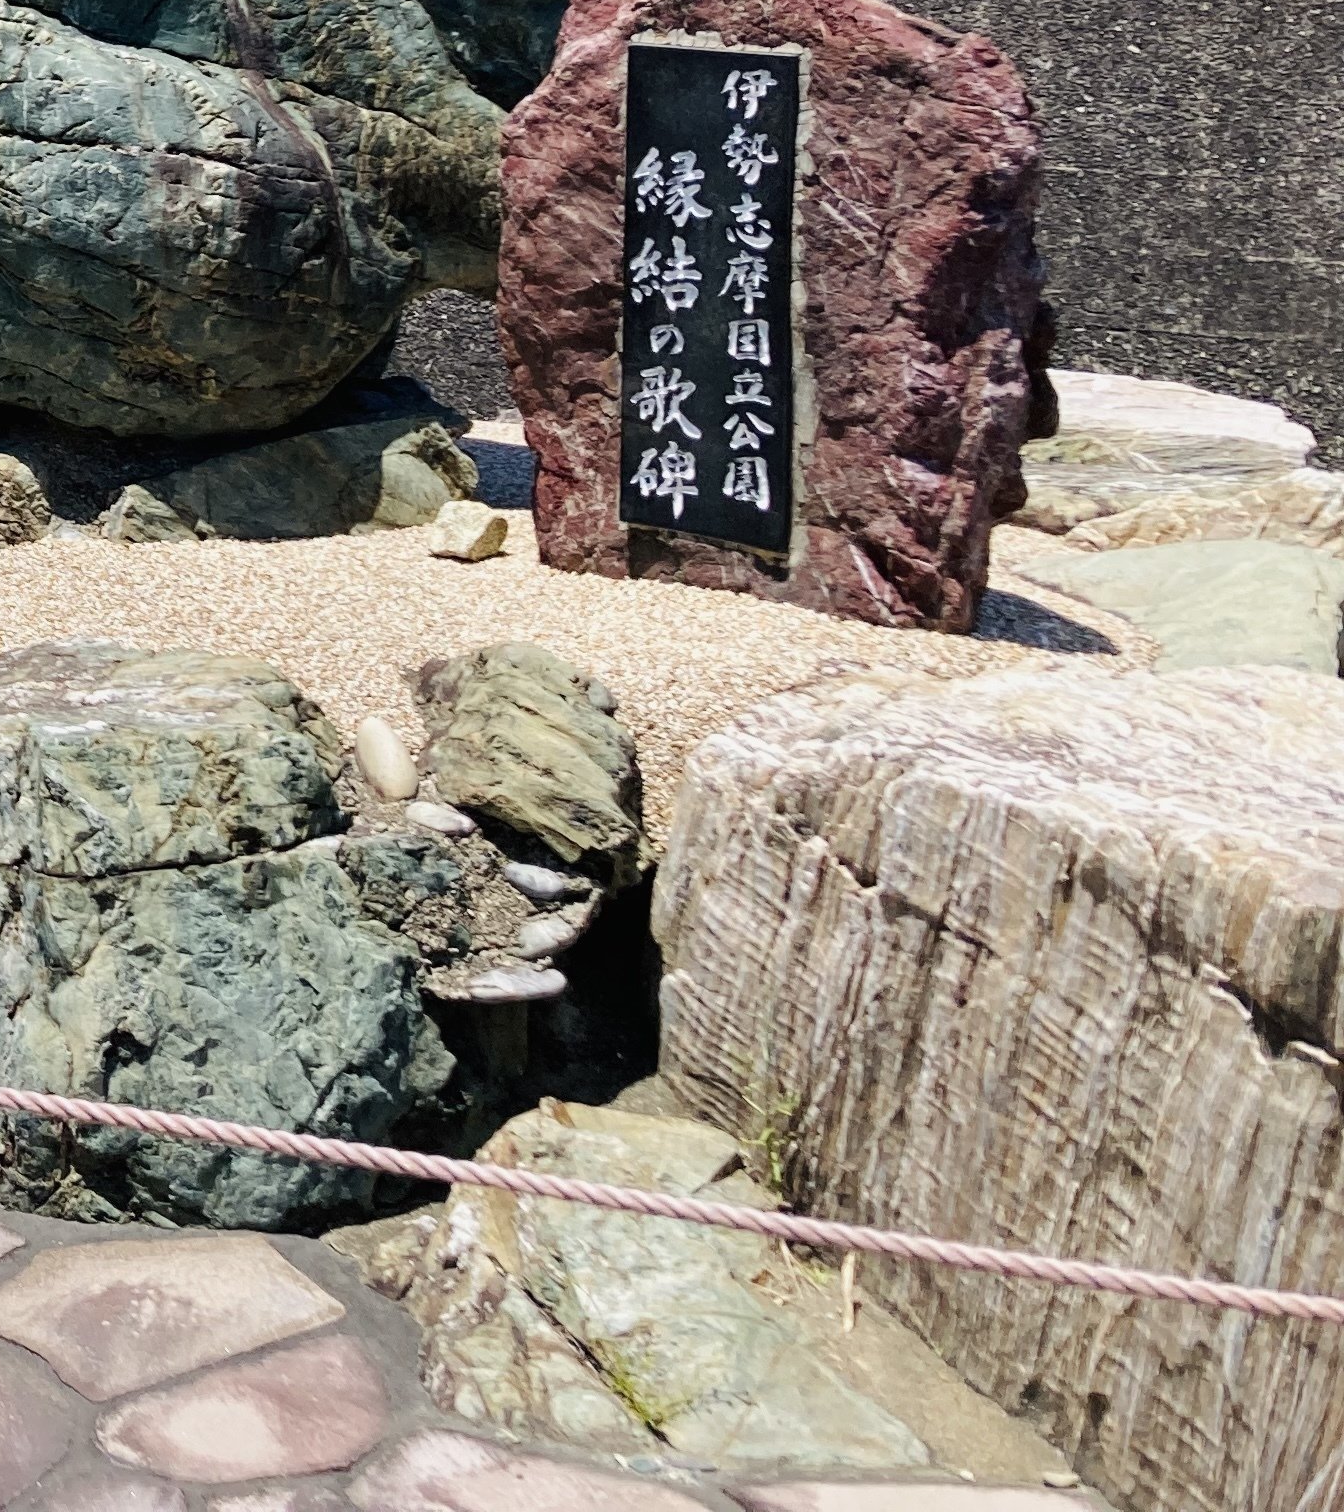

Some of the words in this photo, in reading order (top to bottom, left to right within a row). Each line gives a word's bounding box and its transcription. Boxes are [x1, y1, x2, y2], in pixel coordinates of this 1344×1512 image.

[629, 146, 712, 520] 縁結の歌碑
[717, 68, 779, 512] 伊勢志摩国立公園
